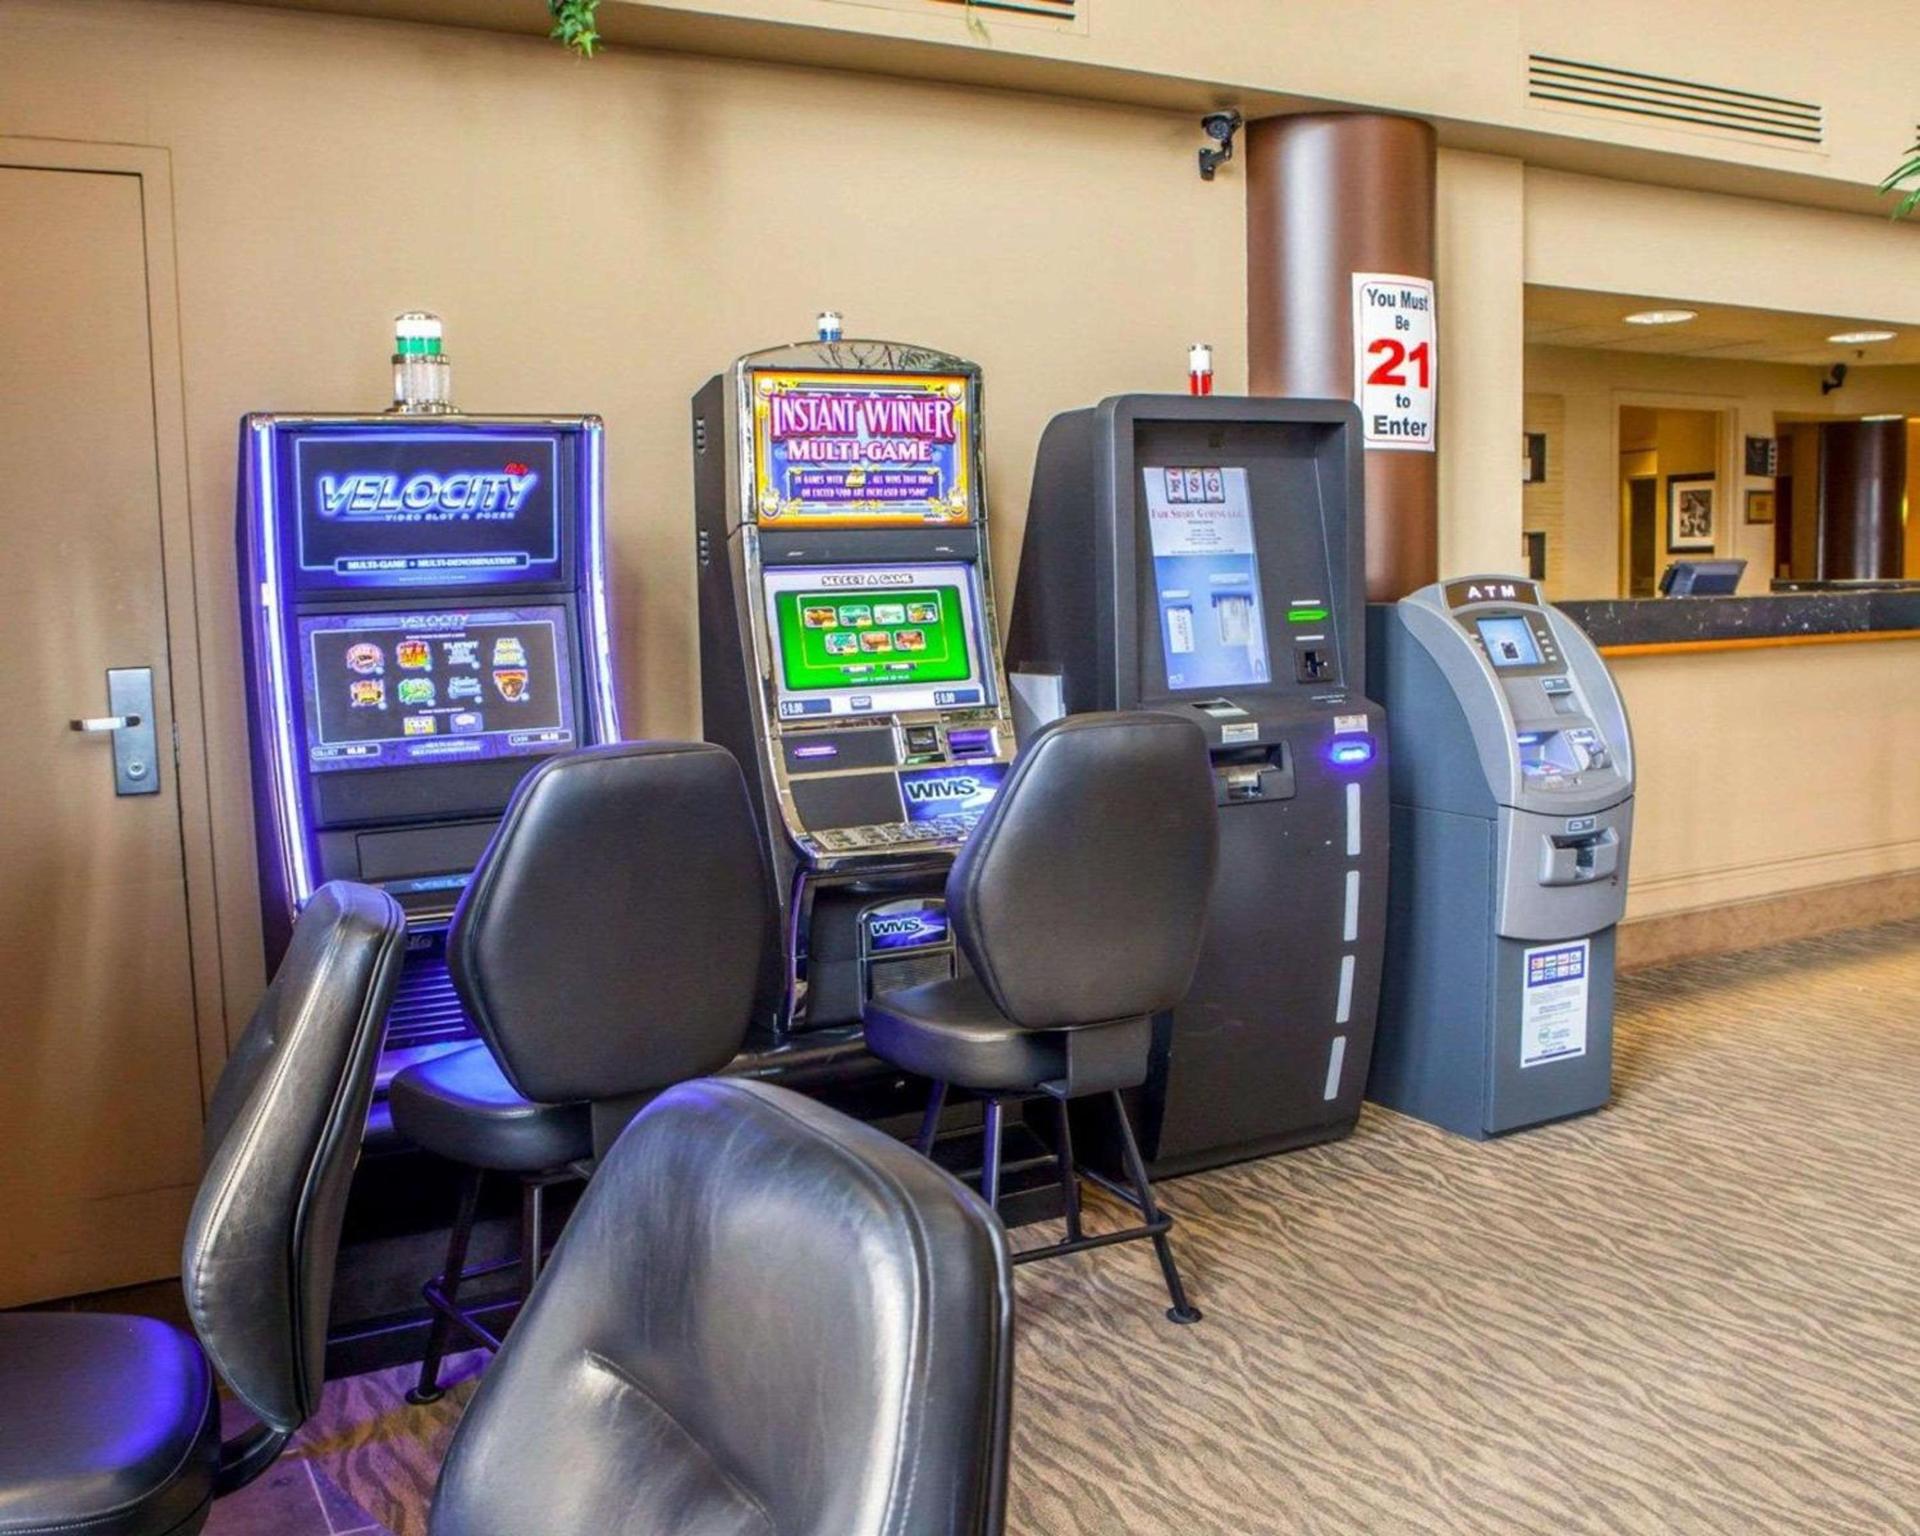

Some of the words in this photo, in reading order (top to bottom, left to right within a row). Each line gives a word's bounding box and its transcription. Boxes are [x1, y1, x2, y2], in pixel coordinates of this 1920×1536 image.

[1367, 288, 1396, 308] You
[1400, 290, 1429, 312] Must
[1395, 314, 1410, 332] Be
[1366, 337, 1429, 389] 21
[1395, 393, 1411, 409] to
[771, 396, 857, 437] INSTANT
[859, 397, 955, 440] WINNER
[1373, 414, 1427, 437] Enter
[788, 439, 932, 462] MULTI-GAME
[319, 474, 537, 515] VELOCITY
[1189, 478, 1200, 493] S
[1207, 478, 1219, 493] G
[1467, 584, 1516, 600] ATM
[907, 777, 977, 800] WMS
[871, 917, 921, 936] WMS
